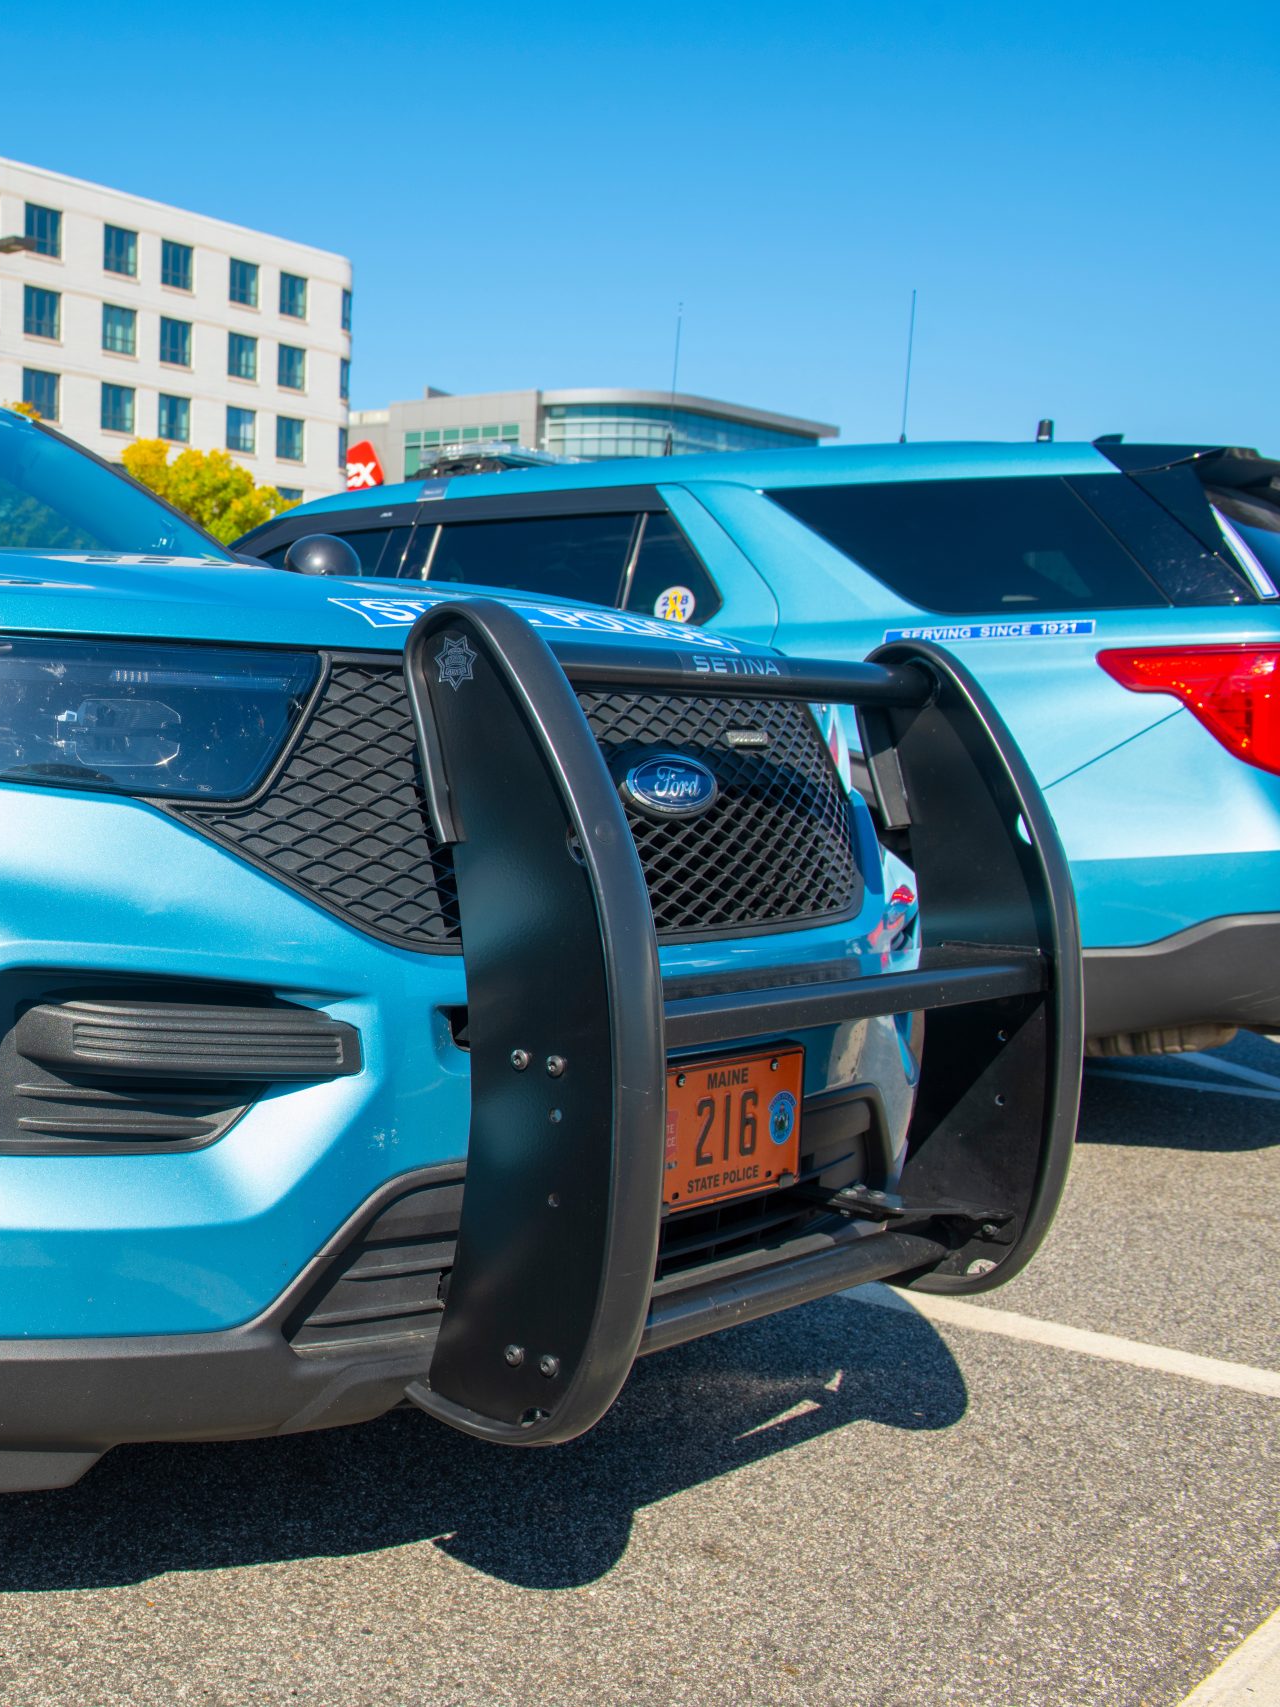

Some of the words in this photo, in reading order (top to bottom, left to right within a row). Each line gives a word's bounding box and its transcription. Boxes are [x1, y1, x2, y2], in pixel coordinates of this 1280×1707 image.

[661, 595, 689, 606] 218
[538, 608, 725, 646] POLICE
[901, 627, 972, 641] SERVING
[980, 624, 1032, 637] SINCE
[1041, 623, 1077, 635] 1921
[692, 655, 781, 675] SETINA
[654, 766, 701, 797] Ford
[707, 1067, 749, 1090] MAINE
[695, 1088, 759, 1167] 216
[687, 1174, 720, 1194] STATE
[722, 1165, 760, 1185] POLICE
